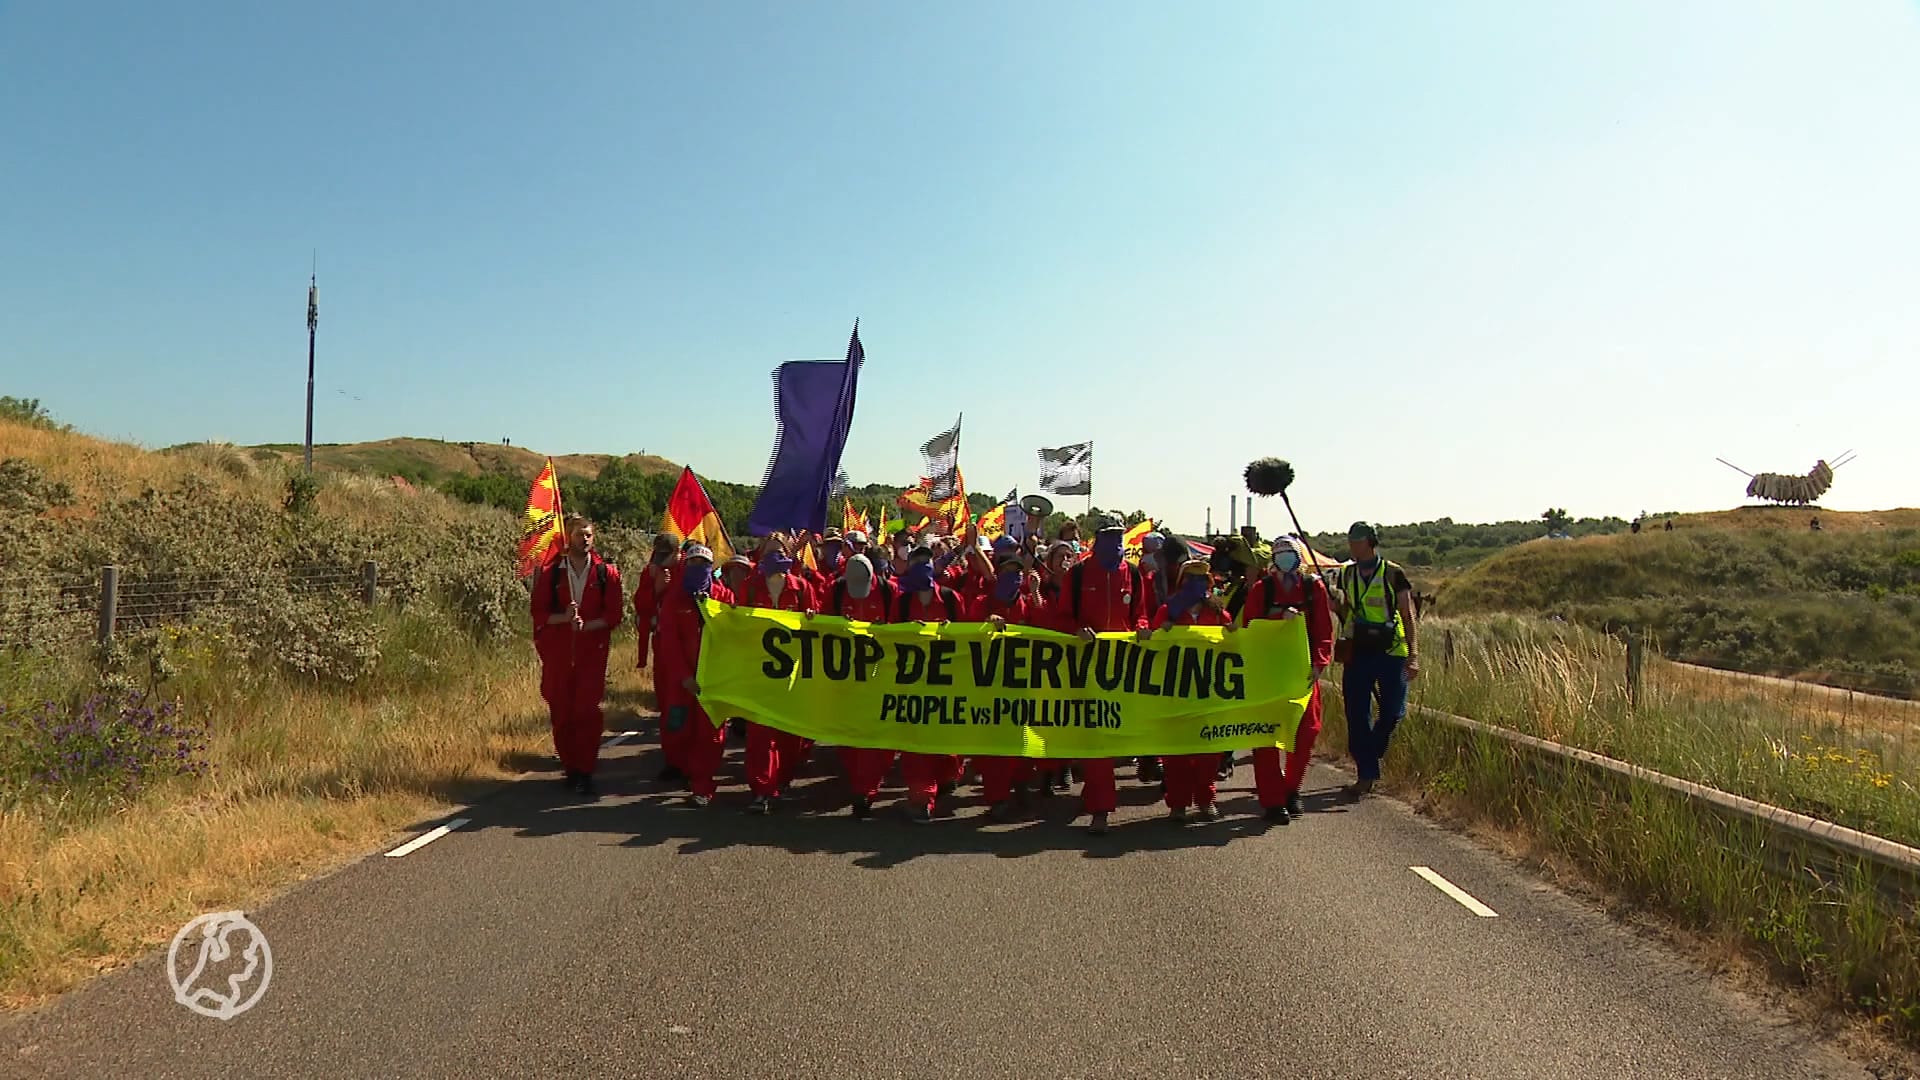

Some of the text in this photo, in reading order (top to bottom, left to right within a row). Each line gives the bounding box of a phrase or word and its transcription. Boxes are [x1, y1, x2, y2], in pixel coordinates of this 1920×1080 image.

[762, 627, 1245, 700] STOP DE VERVUILING
[880, 694, 967, 725] PEOPLE
[993, 697, 1122, 729] POLLUTERS
[1200, 722, 1281, 741] GREENPEACE
